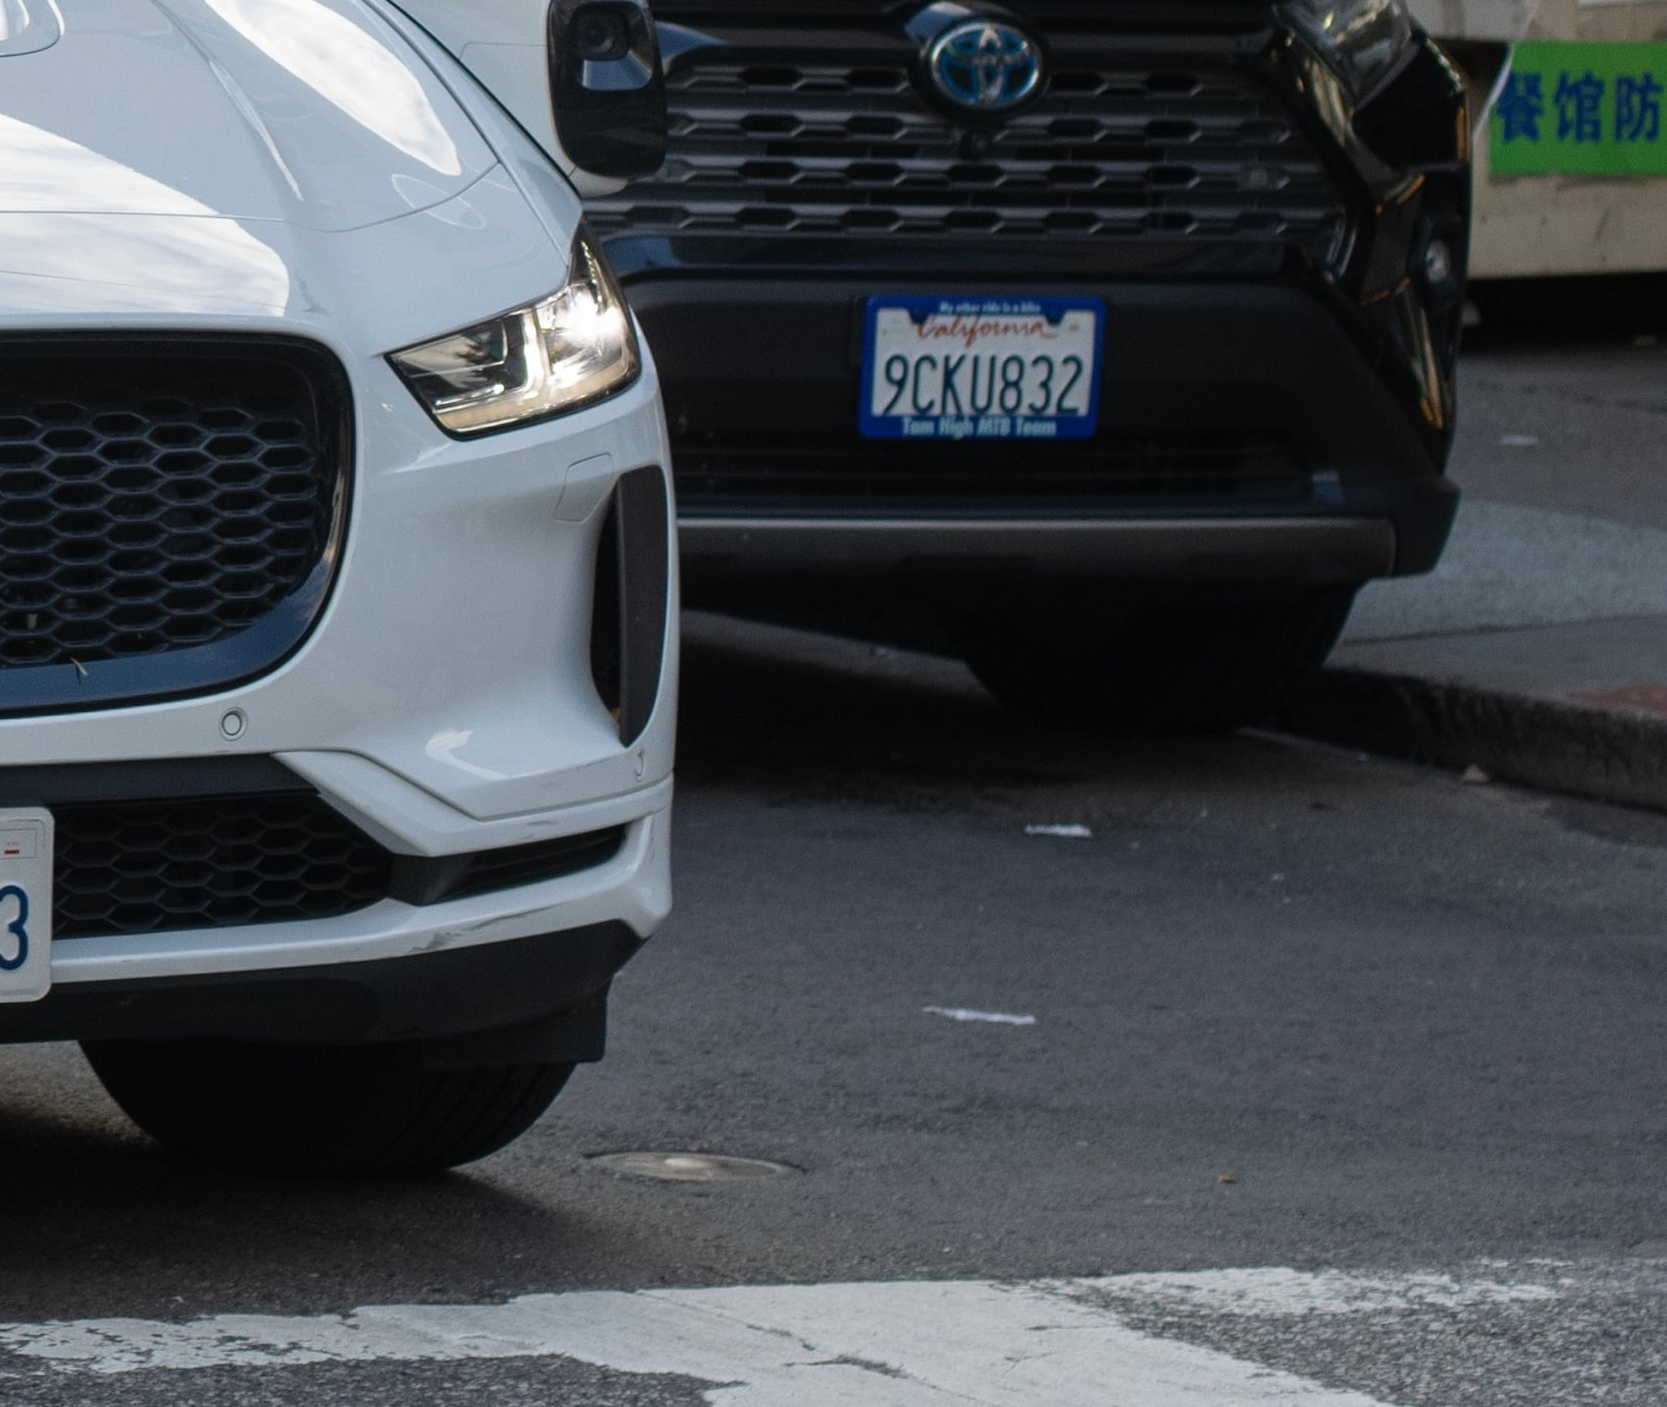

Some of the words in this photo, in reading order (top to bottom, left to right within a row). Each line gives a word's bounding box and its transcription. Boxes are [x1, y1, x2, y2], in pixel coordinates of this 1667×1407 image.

[1496, 69, 1664, 143] 餐馆防
[916, 315, 1058, 348] California
[883, 354, 1084, 415] 9CKU832
[939, 416, 974, 440] High
[977, 416, 1012, 436] MTB
[1016, 416, 1057, 436] Team
